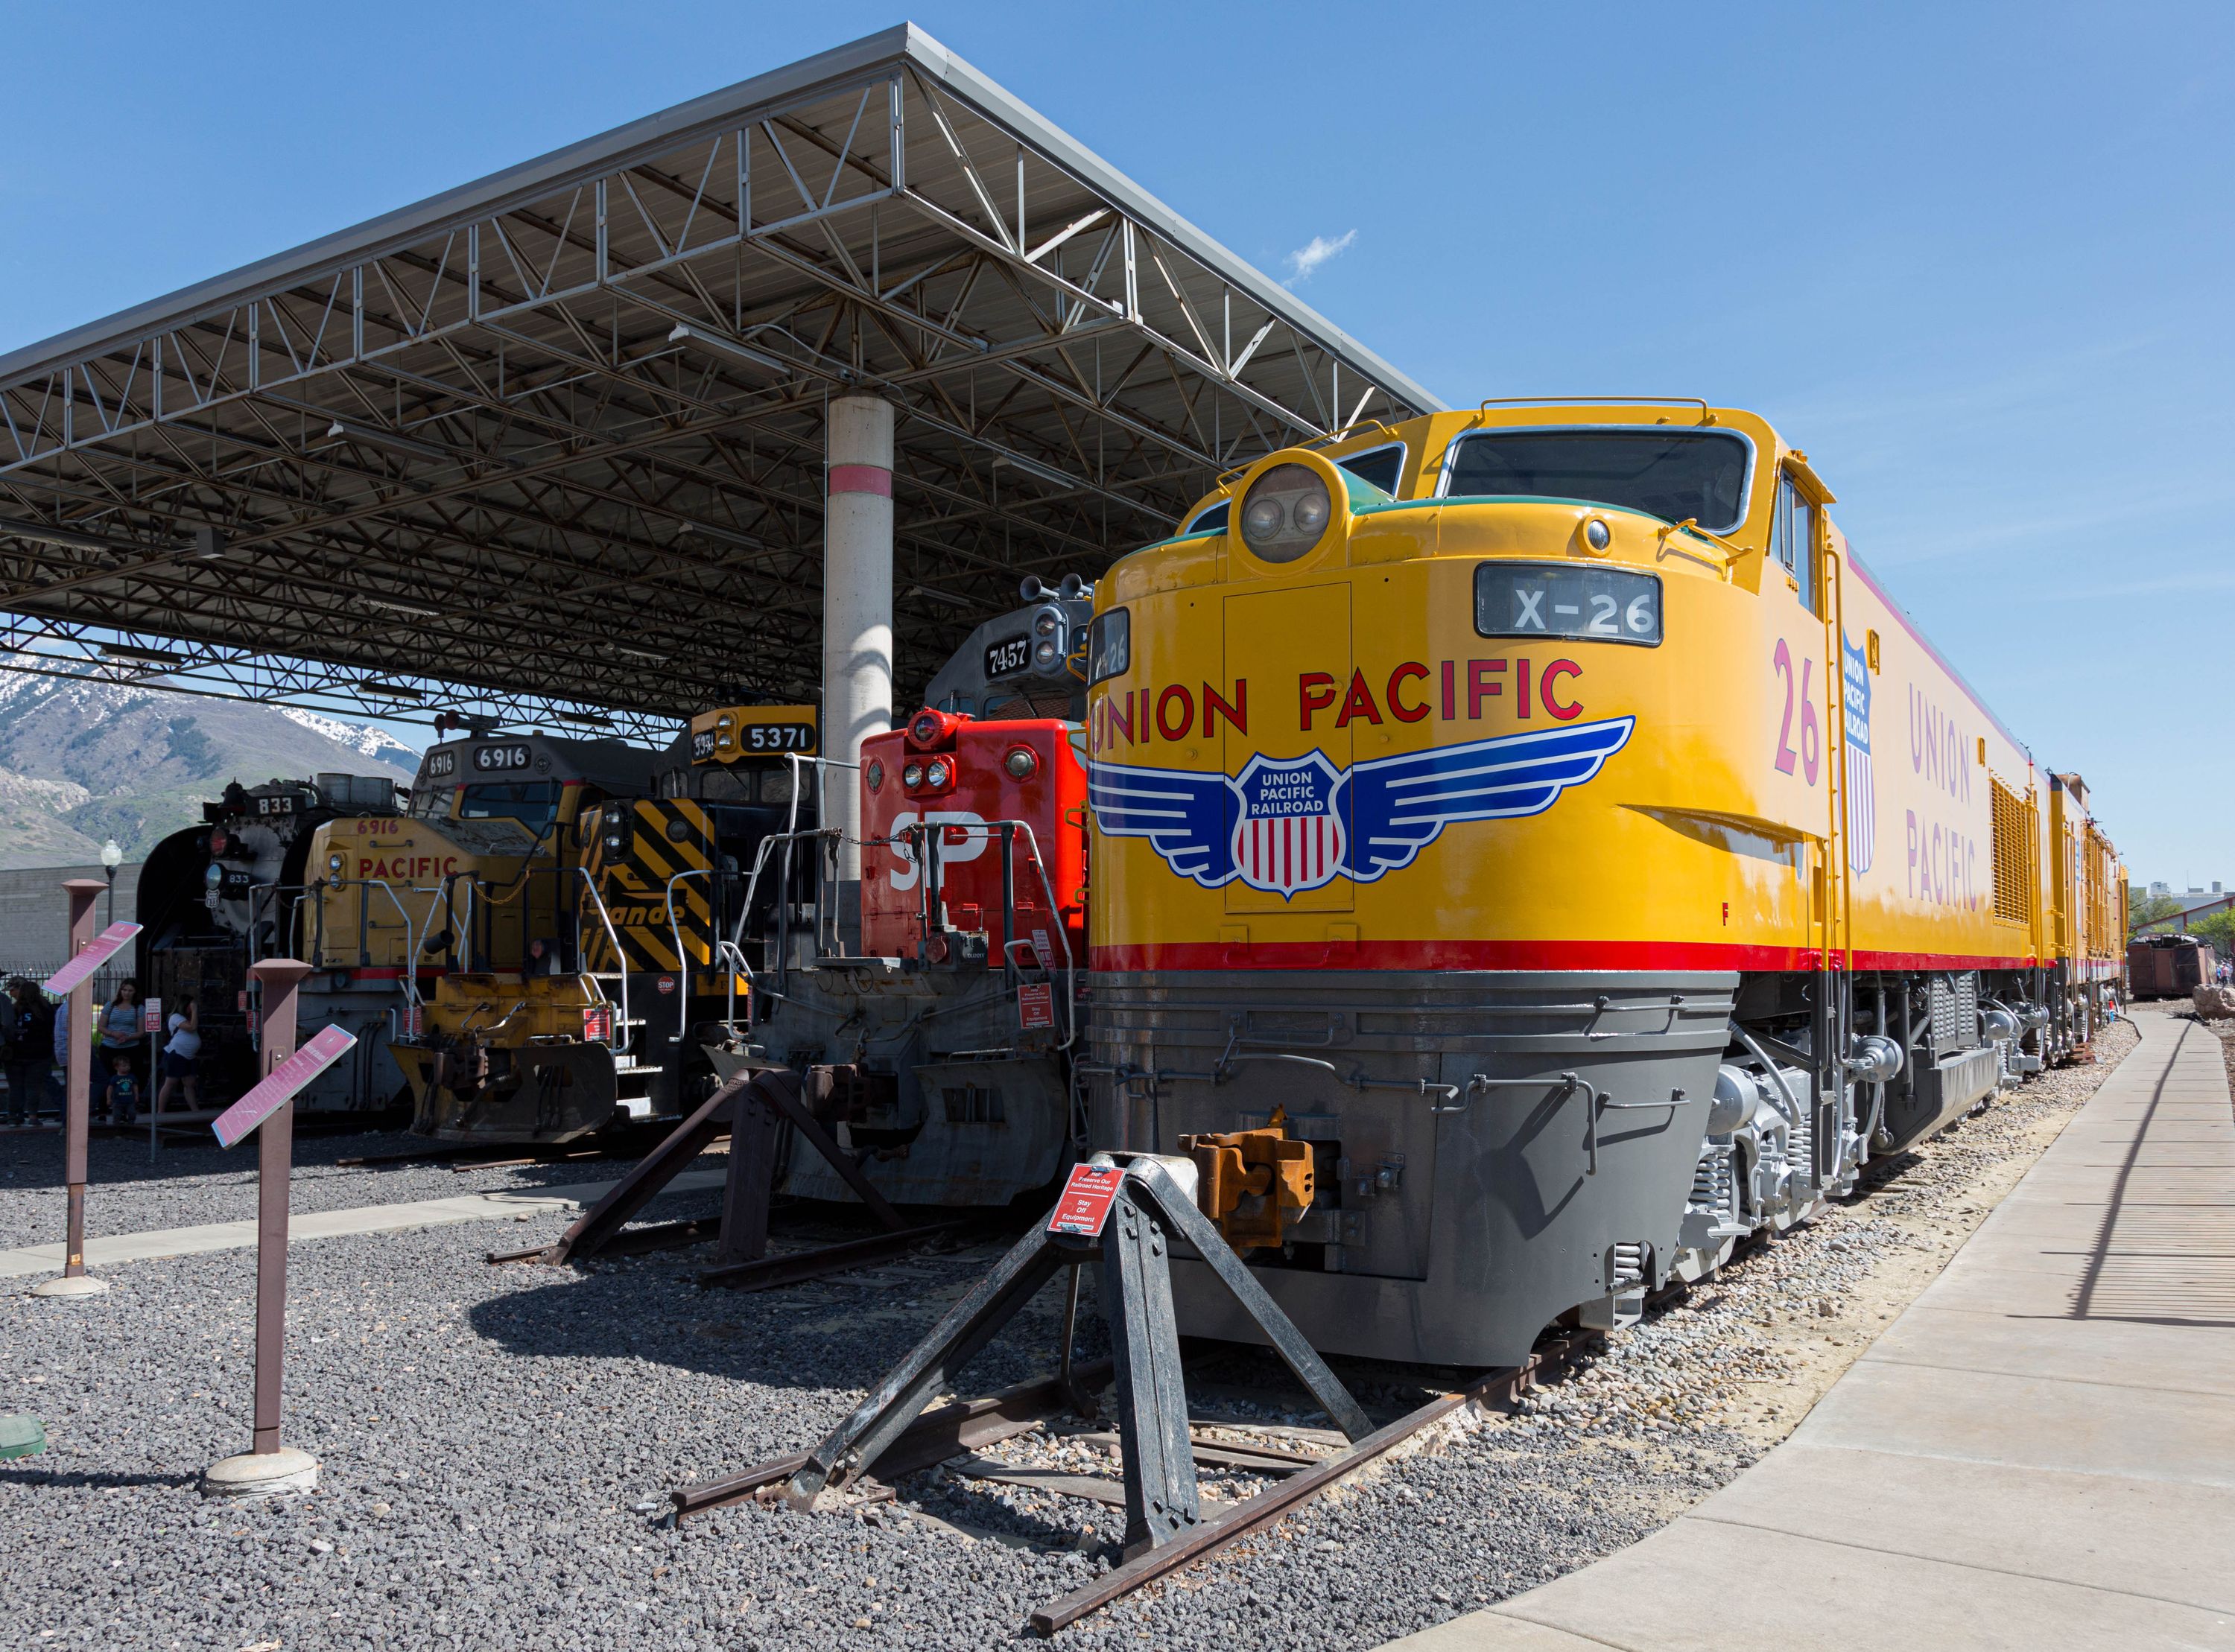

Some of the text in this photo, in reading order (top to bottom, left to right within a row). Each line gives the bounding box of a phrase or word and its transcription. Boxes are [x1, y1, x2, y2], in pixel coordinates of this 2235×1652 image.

[1515, 589, 1655, 633] X-26
[989, 640, 1027, 674] 7457
[1844, 650, 1864, 687] UNION
[1091, 658, 1584, 754] UNION PACIFIC
[1844, 679, 1865, 715] PACIFIC
[1773, 638, 1819, 787] 26
[751, 727, 805, 749] 5371
[1845, 709, 1868, 745] AILROAD
[1909, 682, 1971, 808] UNION
[430, 754, 453, 775] 6916
[481, 747, 526, 768] 6916
[1262, 772, 1312, 787] UNION
[1260, 786, 1315, 801] PACIFIC
[259, 797, 292, 814] 833
[1252, 800, 1324, 816] RAILROAD
[357, 819, 399, 835] 6916
[890, 811, 989, 892] SP
[1906, 809, 1976, 913] PACIFIC
[229, 874, 250, 883] 833
[359, 857, 458, 879] PACIFIC
[1722, 902, 1728, 926] F
[1077, 1199, 1092, 1207] Stay
[1062, 1213, 1095, 1222] Equipment
